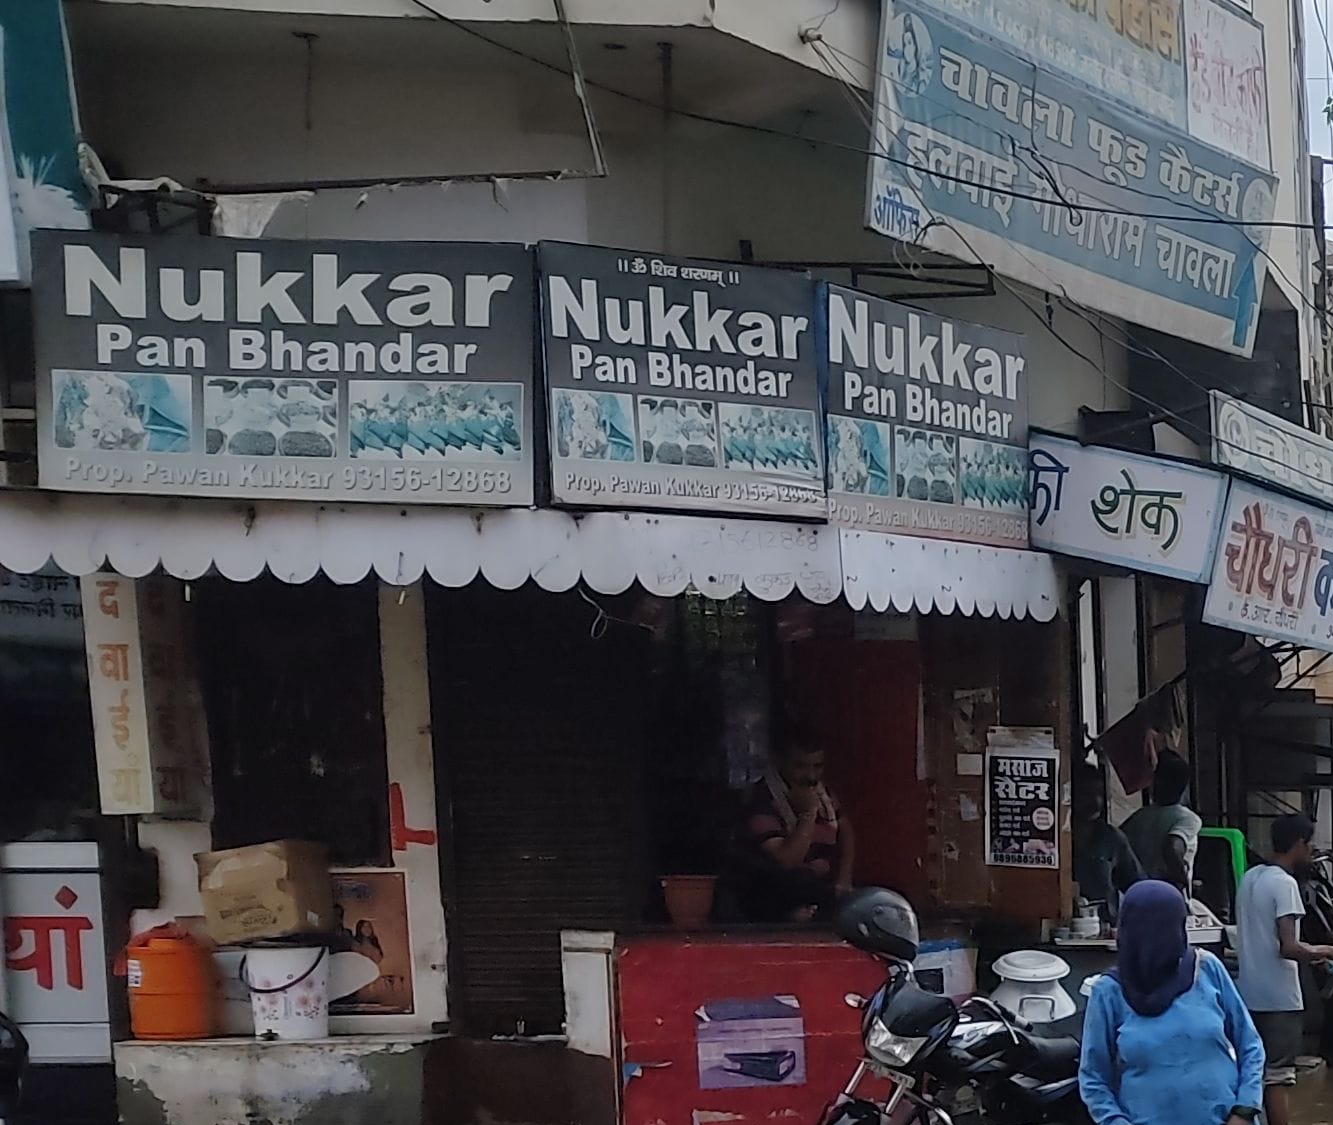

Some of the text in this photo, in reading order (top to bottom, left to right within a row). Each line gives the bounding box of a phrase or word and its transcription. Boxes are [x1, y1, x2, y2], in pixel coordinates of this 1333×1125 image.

[940, 47, 1075, 148] चावला
[1087, 118, 1150, 188] फूड
[63, 244, 514, 328] Nukkar
[650, 259, 678, 279] शिव
[1154, 226, 1236, 299] चावला
[96, 323, 477, 375] Pan Bhandar
[548, 274, 810, 361] Nukkar
[828, 293, 1026, 402] Nukkar
[569, 343, 793, 399] Pan Bhandar
[843, 371, 1014, 440] Pan Bhandar
[64, 457, 513, 494] Prop. Pawan Kukkar 93156-12868
[565, 471, 606, 493] Prop.
[610, 475, 662, 496] Pawan
[664, 477, 722, 500] Kukkar
[1090, 468, 1183, 552] शेक
[827, 498, 863, 524] Prop.
[865, 502, 909, 528] Pawan
[911, 507, 957, 531] Kukkar
[1225, 501, 1319, 610] चौधरी
[996, 758, 1049, 778] मसाज
